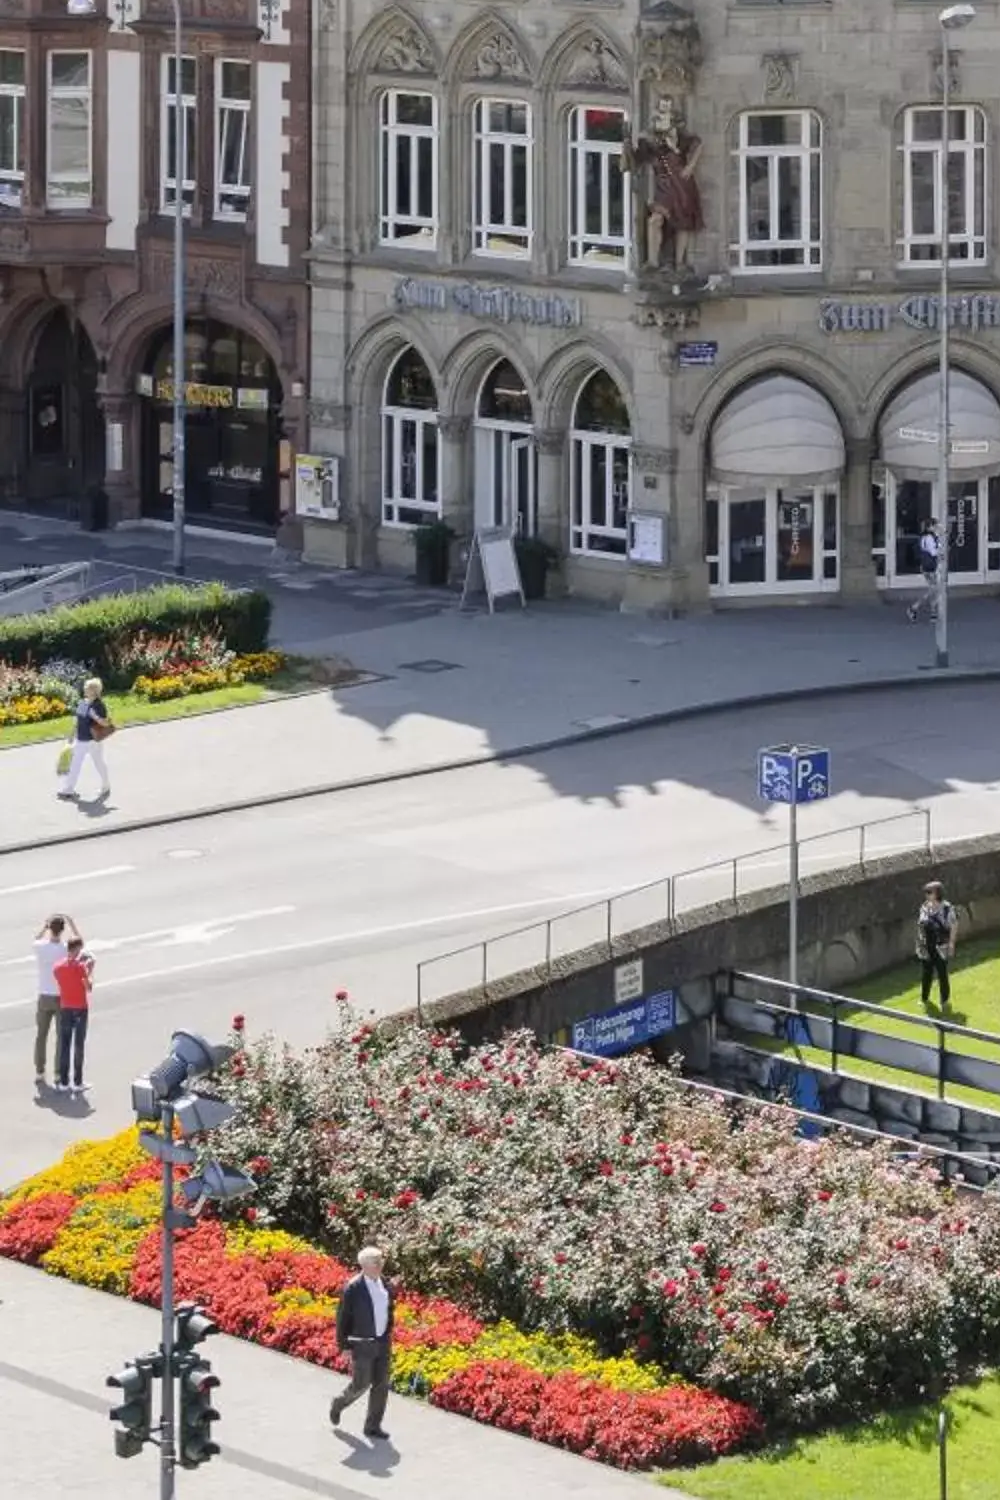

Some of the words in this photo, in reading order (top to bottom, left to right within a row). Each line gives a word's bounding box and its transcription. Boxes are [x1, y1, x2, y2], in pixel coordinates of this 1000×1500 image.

[819, 298, 892, 334] Zum
[762, 756, 776, 784] P
[797, 760, 812, 788] P
